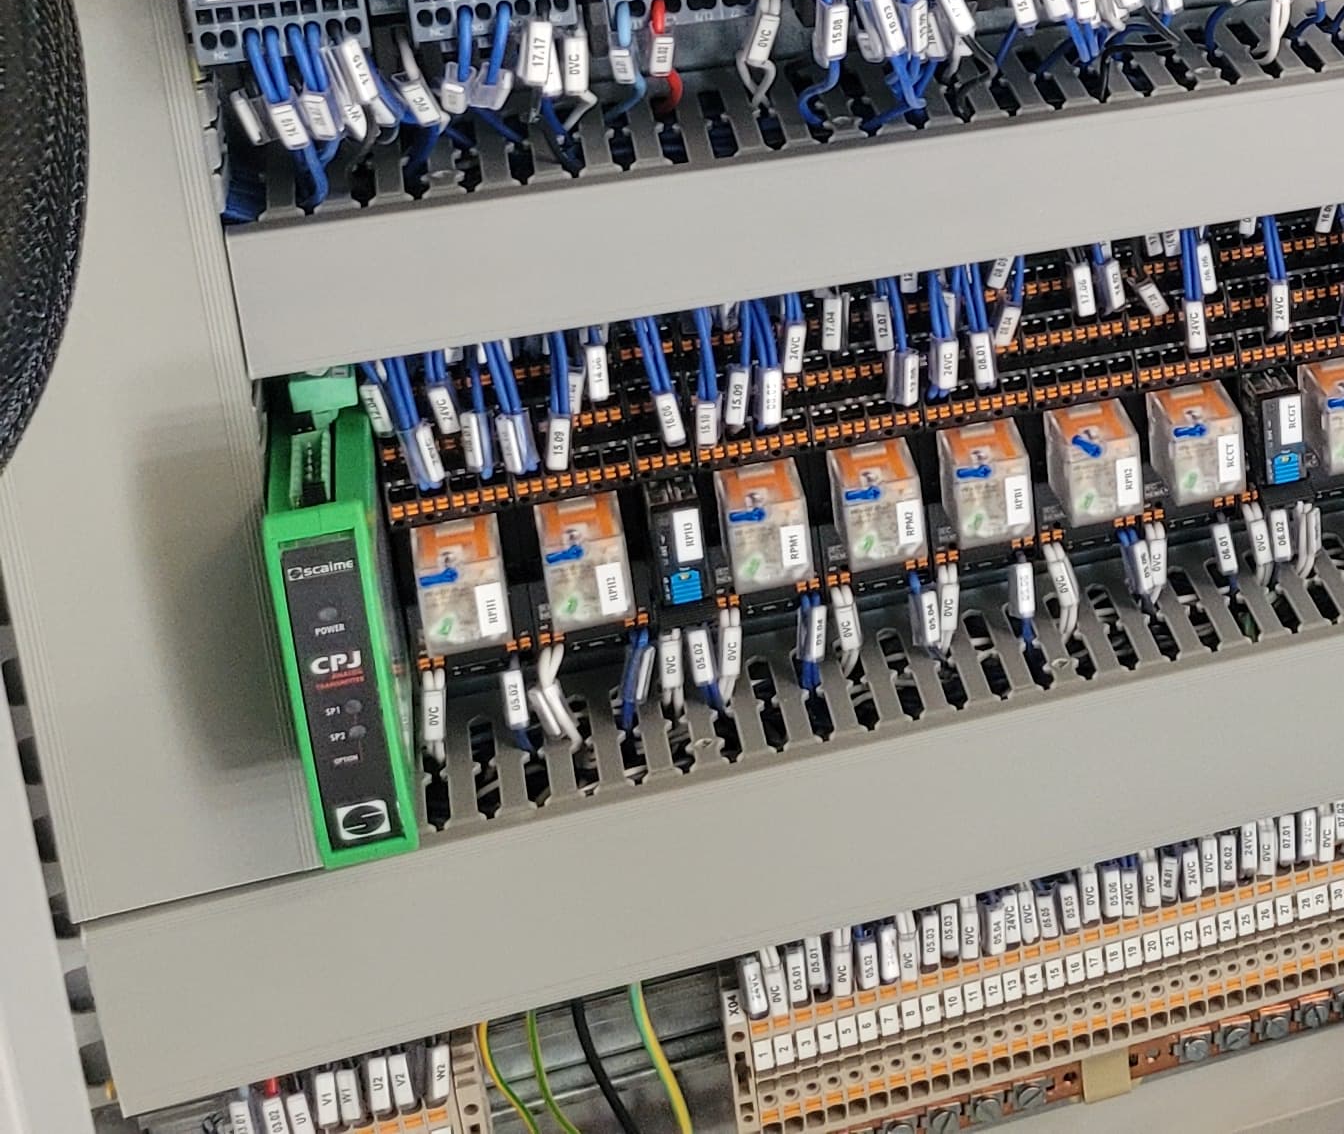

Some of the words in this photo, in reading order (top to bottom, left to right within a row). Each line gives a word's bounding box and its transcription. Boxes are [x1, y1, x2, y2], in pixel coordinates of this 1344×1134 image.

[758, 29, 772, 48] 0VC
[832, 19, 843, 44] 15.08
[214, 51, 228, 60] NC
[531, 37, 547, 67] 17.17
[569, 53, 580, 75] 0VC
[1191, 312, 1200, 336] 24VC
[789, 337, 800, 360] 24VC
[943, 353, 953, 376] 24VC
[731, 384, 743, 410] 15.09
[1288, 404, 1297, 429] RCGT
[905, 511, 915, 536] RPM2
[790, 534, 799, 559] RPM1
[1218, 535, 1232, 560] 06.01
[303, 560, 354, 577] scaime
[1152, 554, 1162, 573] 0VC
[606, 576, 618, 602] RPH2
[1056, 575, 1069, 594] 0VC
[486, 599, 497, 624] RPH1
[315, 623, 345, 636] POWER
[842, 620, 853, 638] 0VC
[310, 650, 362, 674] CPJ
[667, 656, 676, 674] 0VC
[694, 643, 705, 669] 05.02
[508, 683, 520, 711] 05.02
[325, 706, 340, 716] SP1
[329, 732, 346, 742] SP2
[333, 753, 358, 765] OPTION
[1322, 828, 1331, 848] 0VC
[1262, 843, 1271, 862] 0VC
[1334, 888, 1343, 900] 30
[1127, 946, 1137, 957] 19
[1147, 940, 1156, 952] 20
[1109, 950, 1119, 962] 18
[969, 989, 978, 1001] 11
[989, 983, 999, 996] 12
[728, 994, 739, 1016] X04
[948, 996, 958, 1008] 10
[842, 1027, 852, 1036] 5
[862, 1021, 872, 1030] 6
[395, 1074, 405, 1086] V2
[436, 1064, 445, 1080] W2
[373, 1076, 383, 1091] U2
